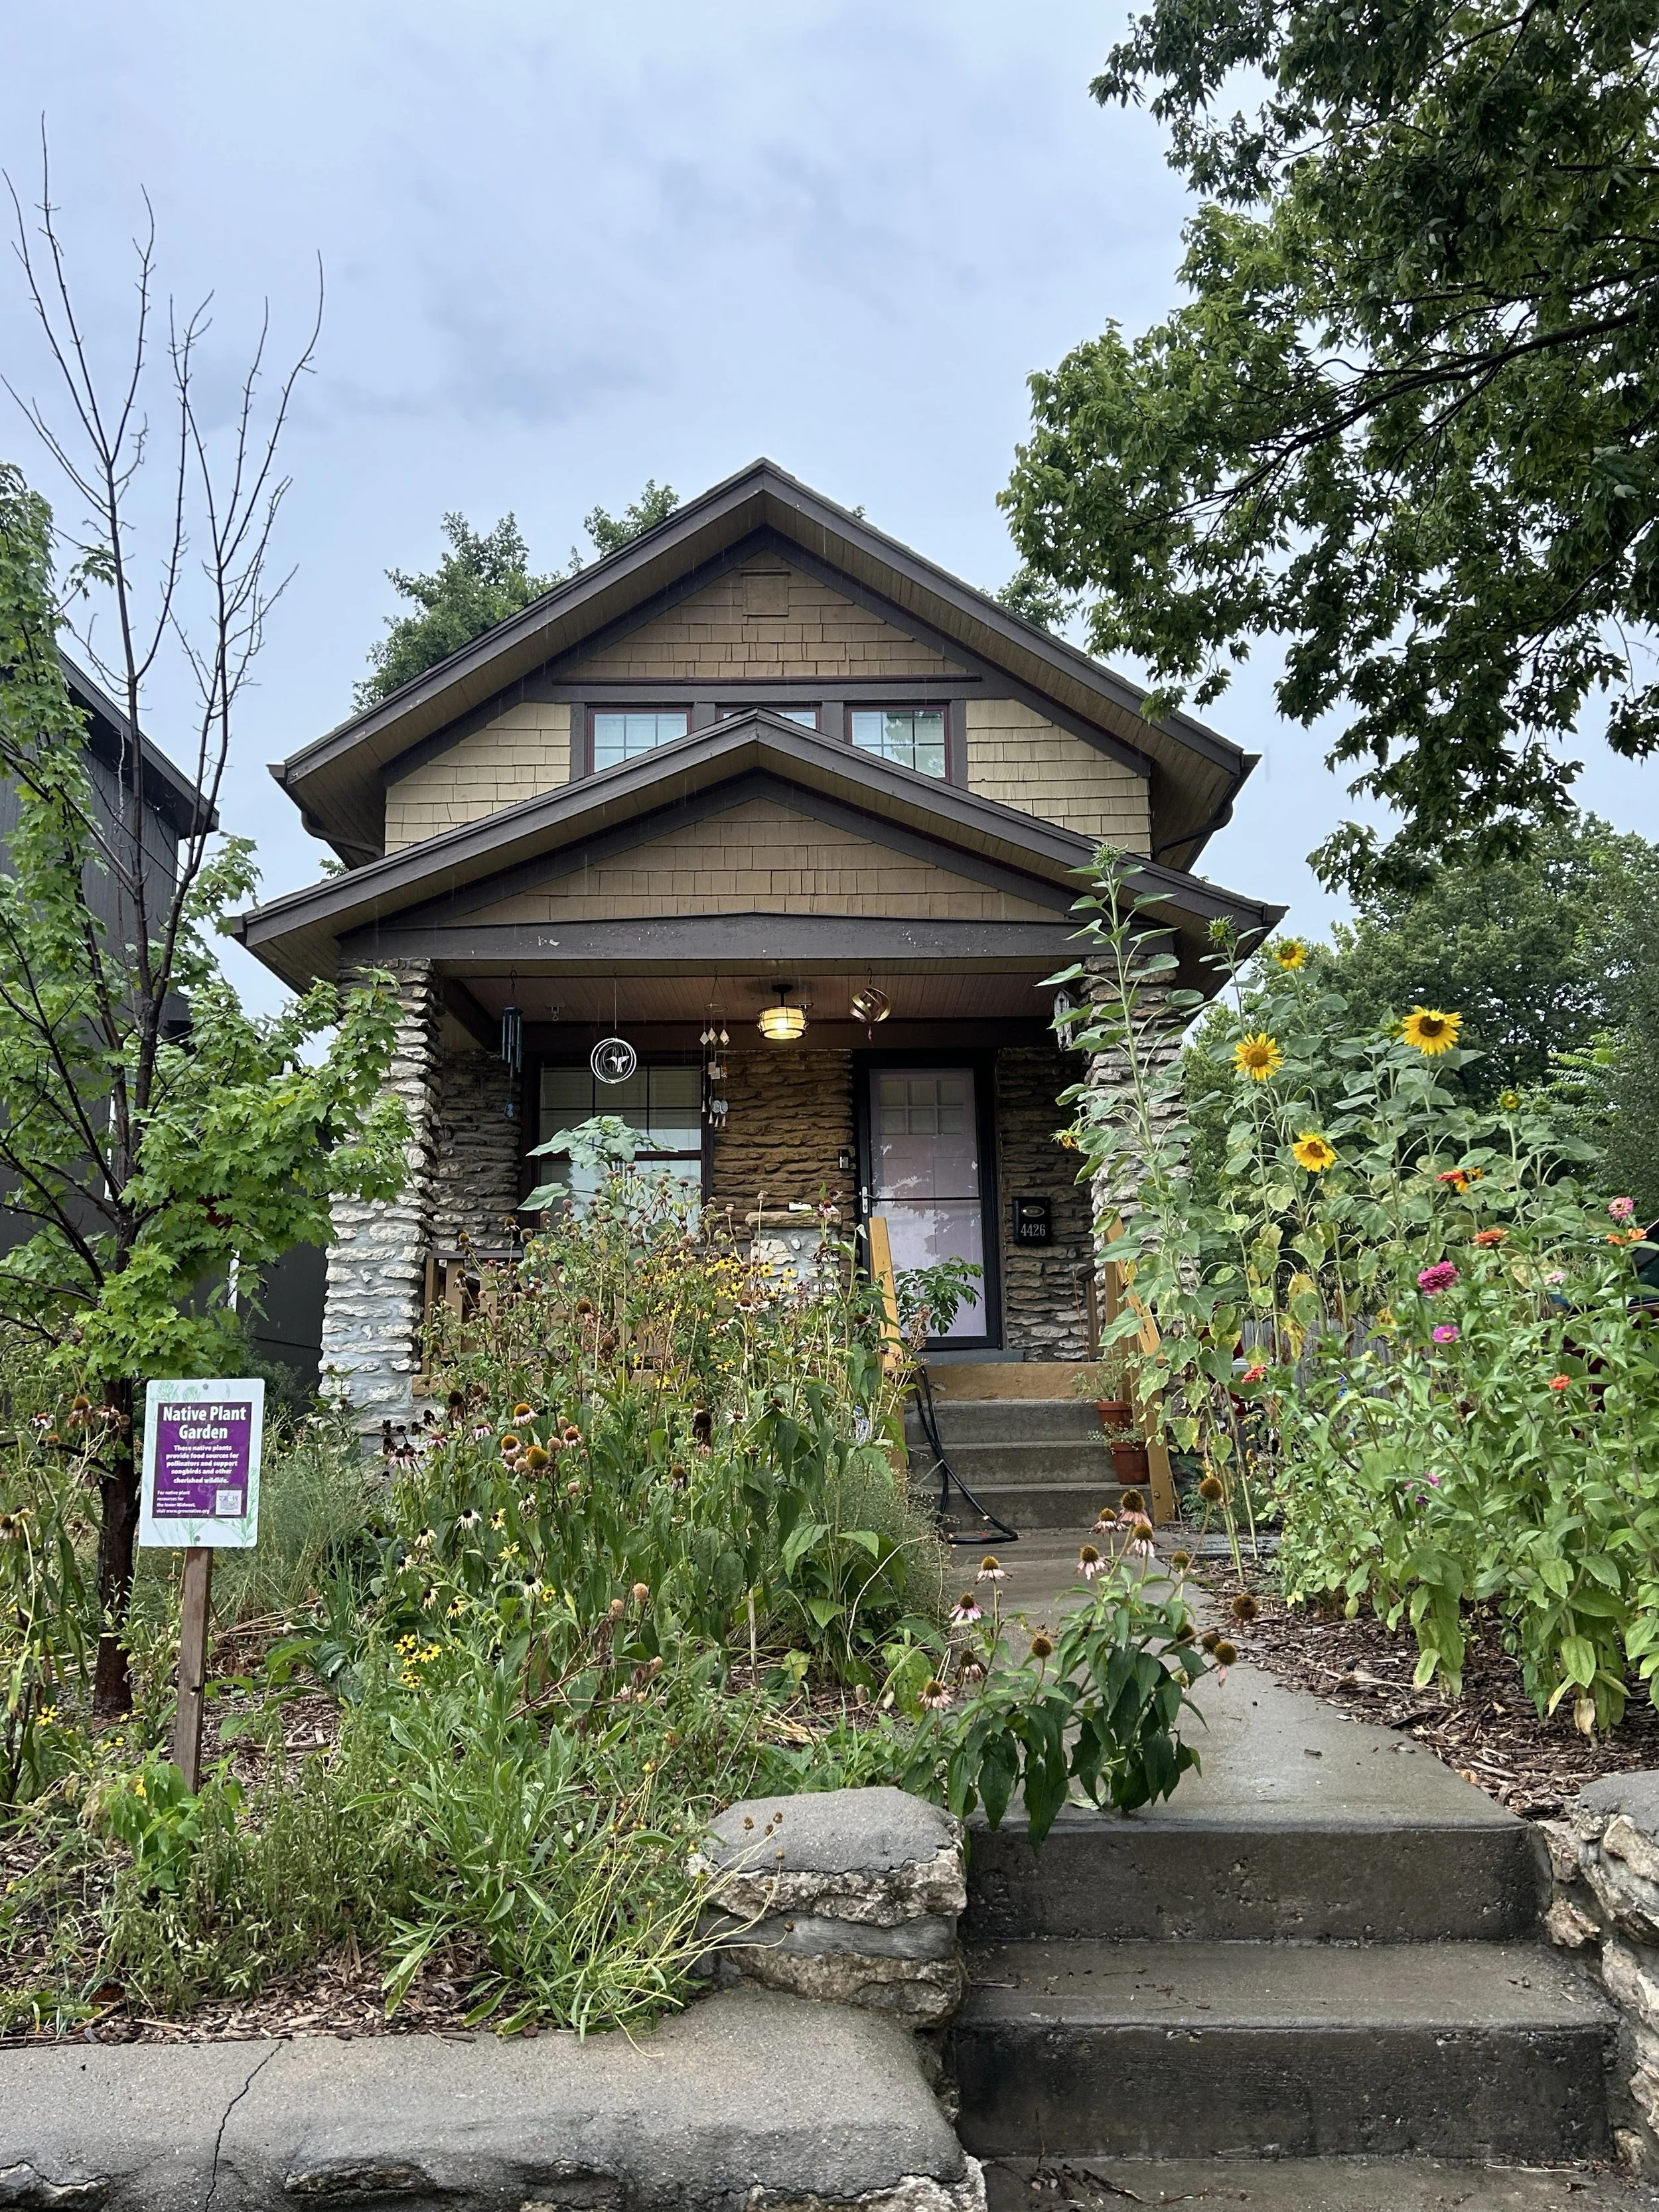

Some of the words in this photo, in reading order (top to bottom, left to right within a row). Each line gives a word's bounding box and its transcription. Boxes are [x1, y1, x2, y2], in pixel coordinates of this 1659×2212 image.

[1021, 1224, 1046, 1236] 4426
[163, 1406, 206, 1421] Native
[210, 1406, 246, 1420] Plant
[179, 1424, 228, 1439] Garden
